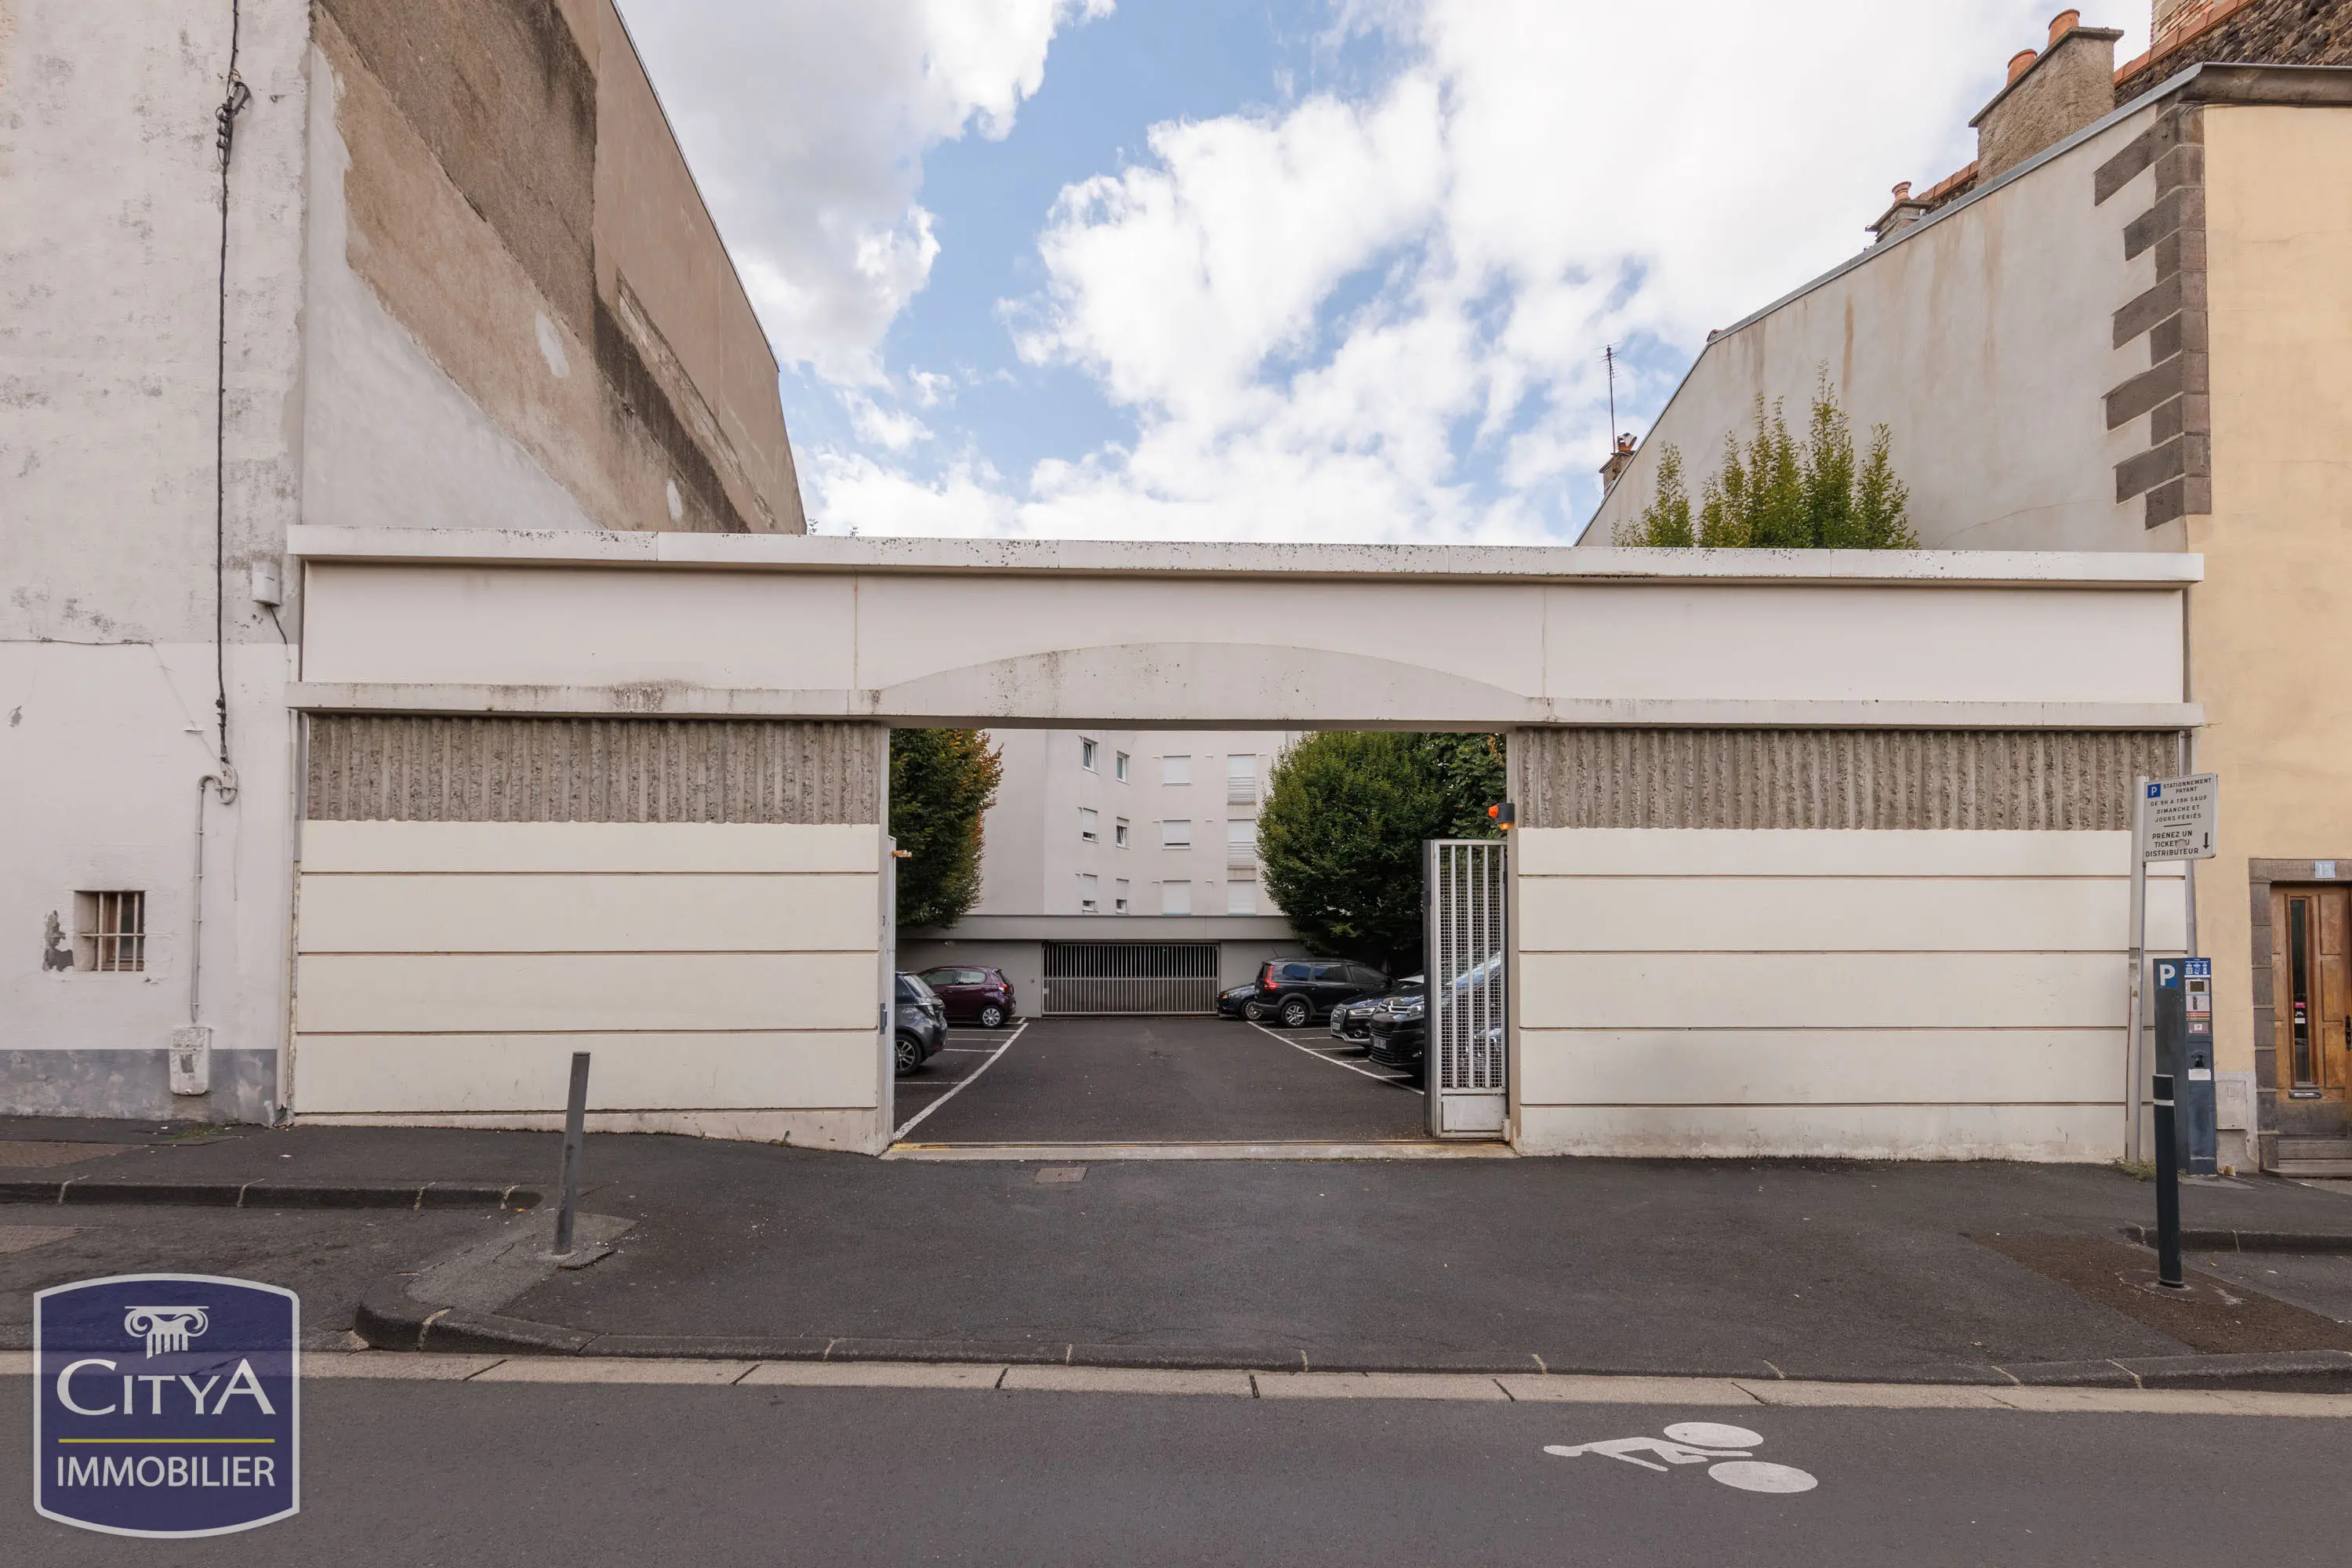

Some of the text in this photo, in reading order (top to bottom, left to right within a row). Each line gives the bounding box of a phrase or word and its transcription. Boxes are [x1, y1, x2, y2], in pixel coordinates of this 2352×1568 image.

[2163, 779, 2212, 789] STATIONNEMENT
[2151, 786, 2158, 796] P
[2157, 805, 2190, 814] DIMANCHE
[2152, 831, 2180, 840] PRENEZ
[2145, 848, 2199, 858] DISTRIBUTEUR
[2159, 964, 2176, 986] P
